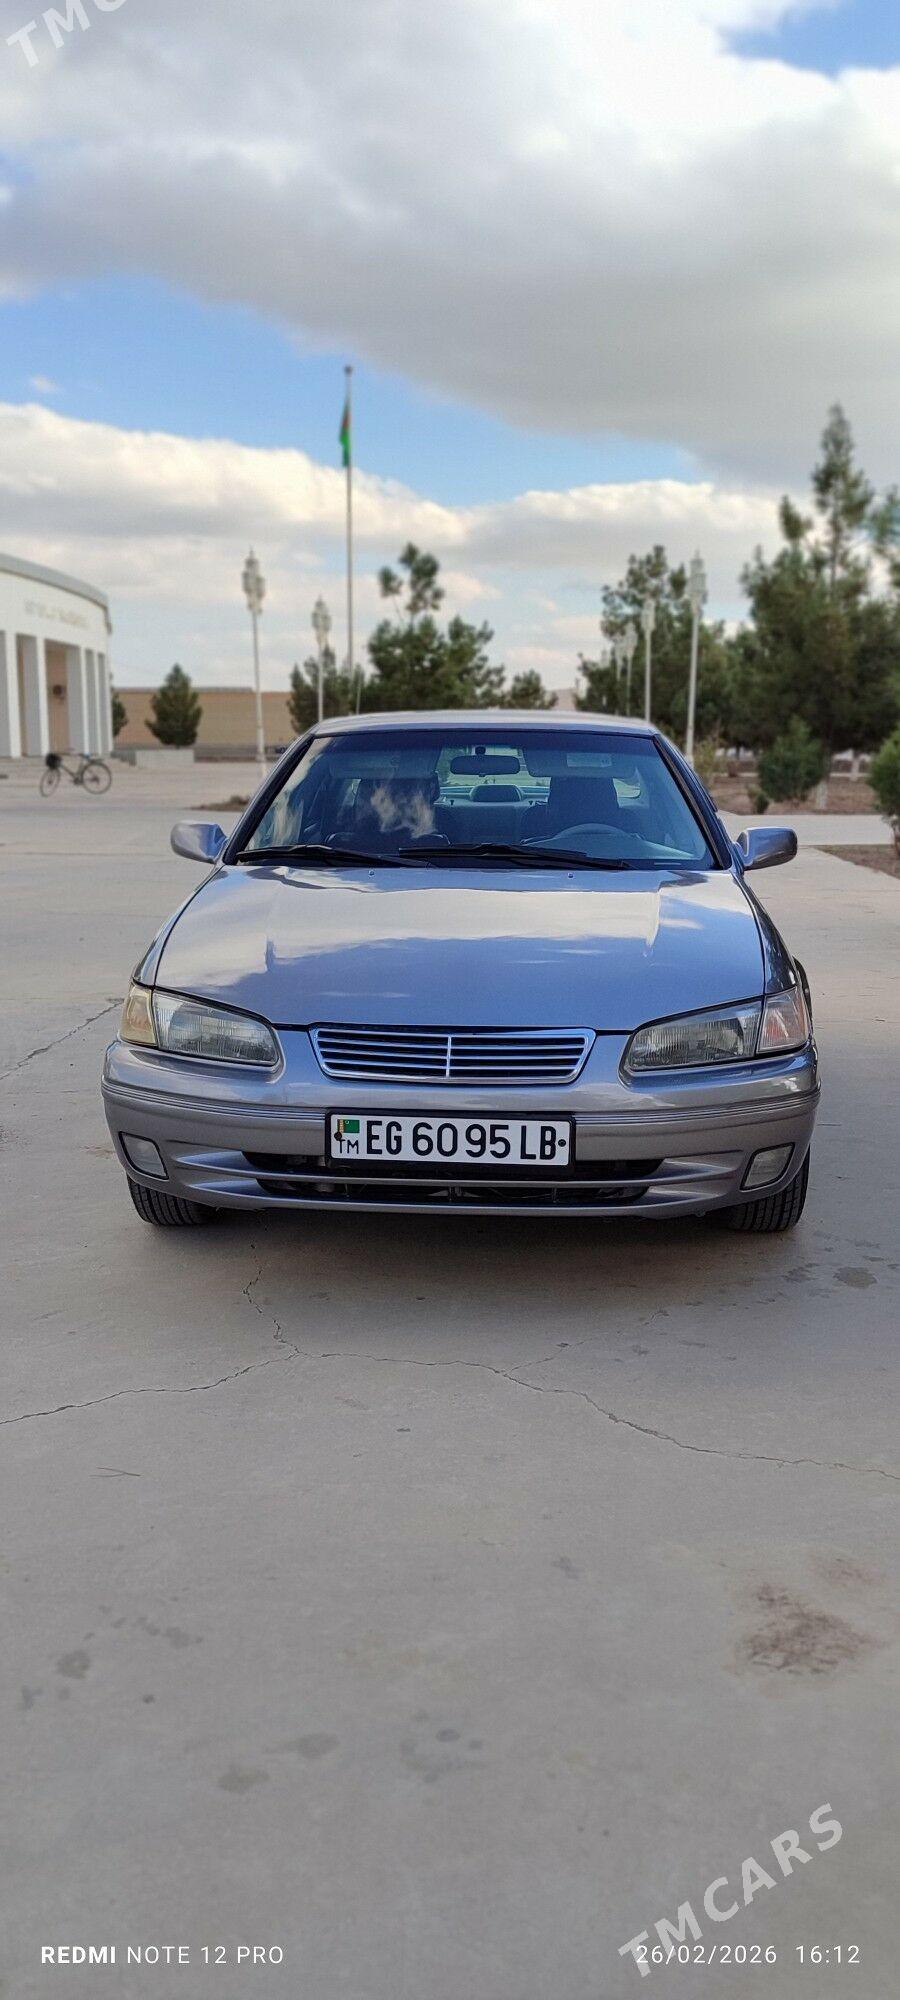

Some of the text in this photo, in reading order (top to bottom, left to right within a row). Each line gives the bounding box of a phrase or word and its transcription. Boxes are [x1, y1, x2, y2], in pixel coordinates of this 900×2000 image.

[338, 1138, 360, 1155] TM
[366, 1120, 402, 1156] EG
[520, 1125, 556, 1160] LB
